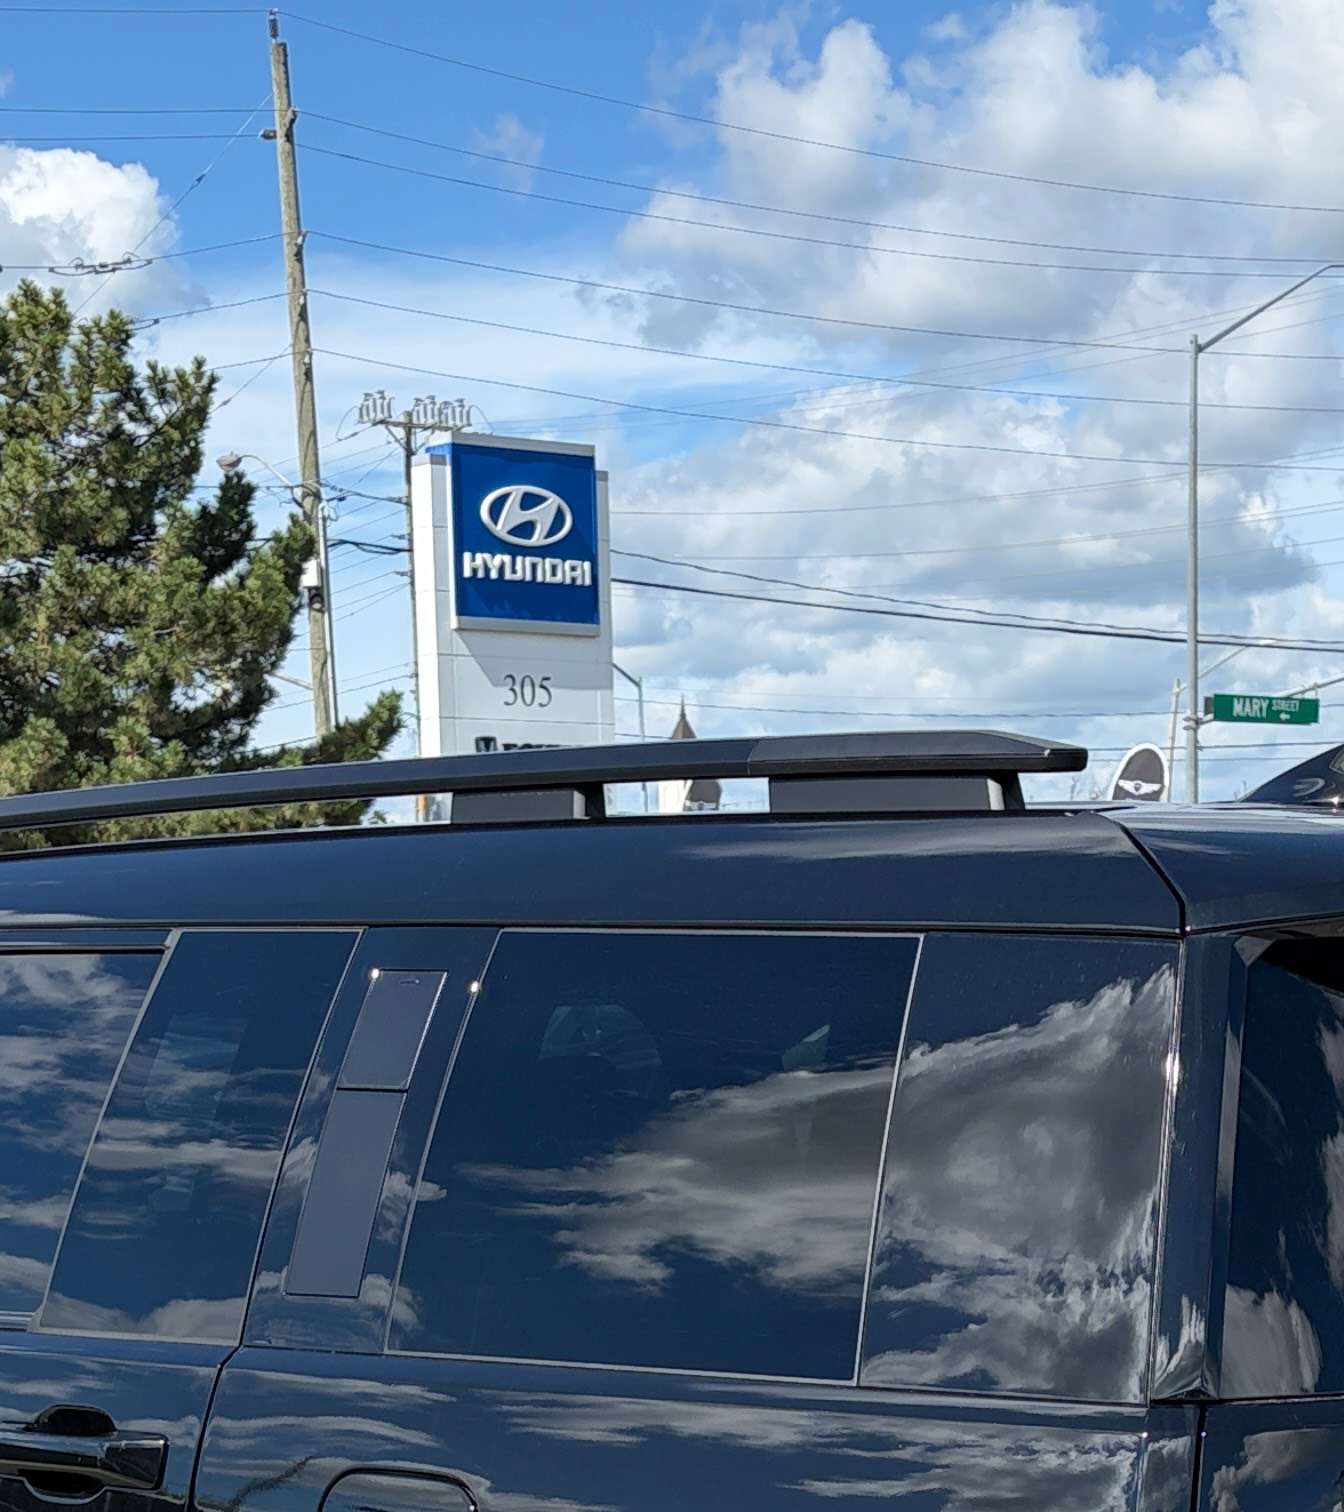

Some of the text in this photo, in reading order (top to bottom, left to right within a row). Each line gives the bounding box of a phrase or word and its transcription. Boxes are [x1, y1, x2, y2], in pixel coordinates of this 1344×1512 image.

[462, 551, 593, 587] HYUNDAI
[503, 674, 554, 708] 305
[1232, 696, 1300, 719] MARY STREET
